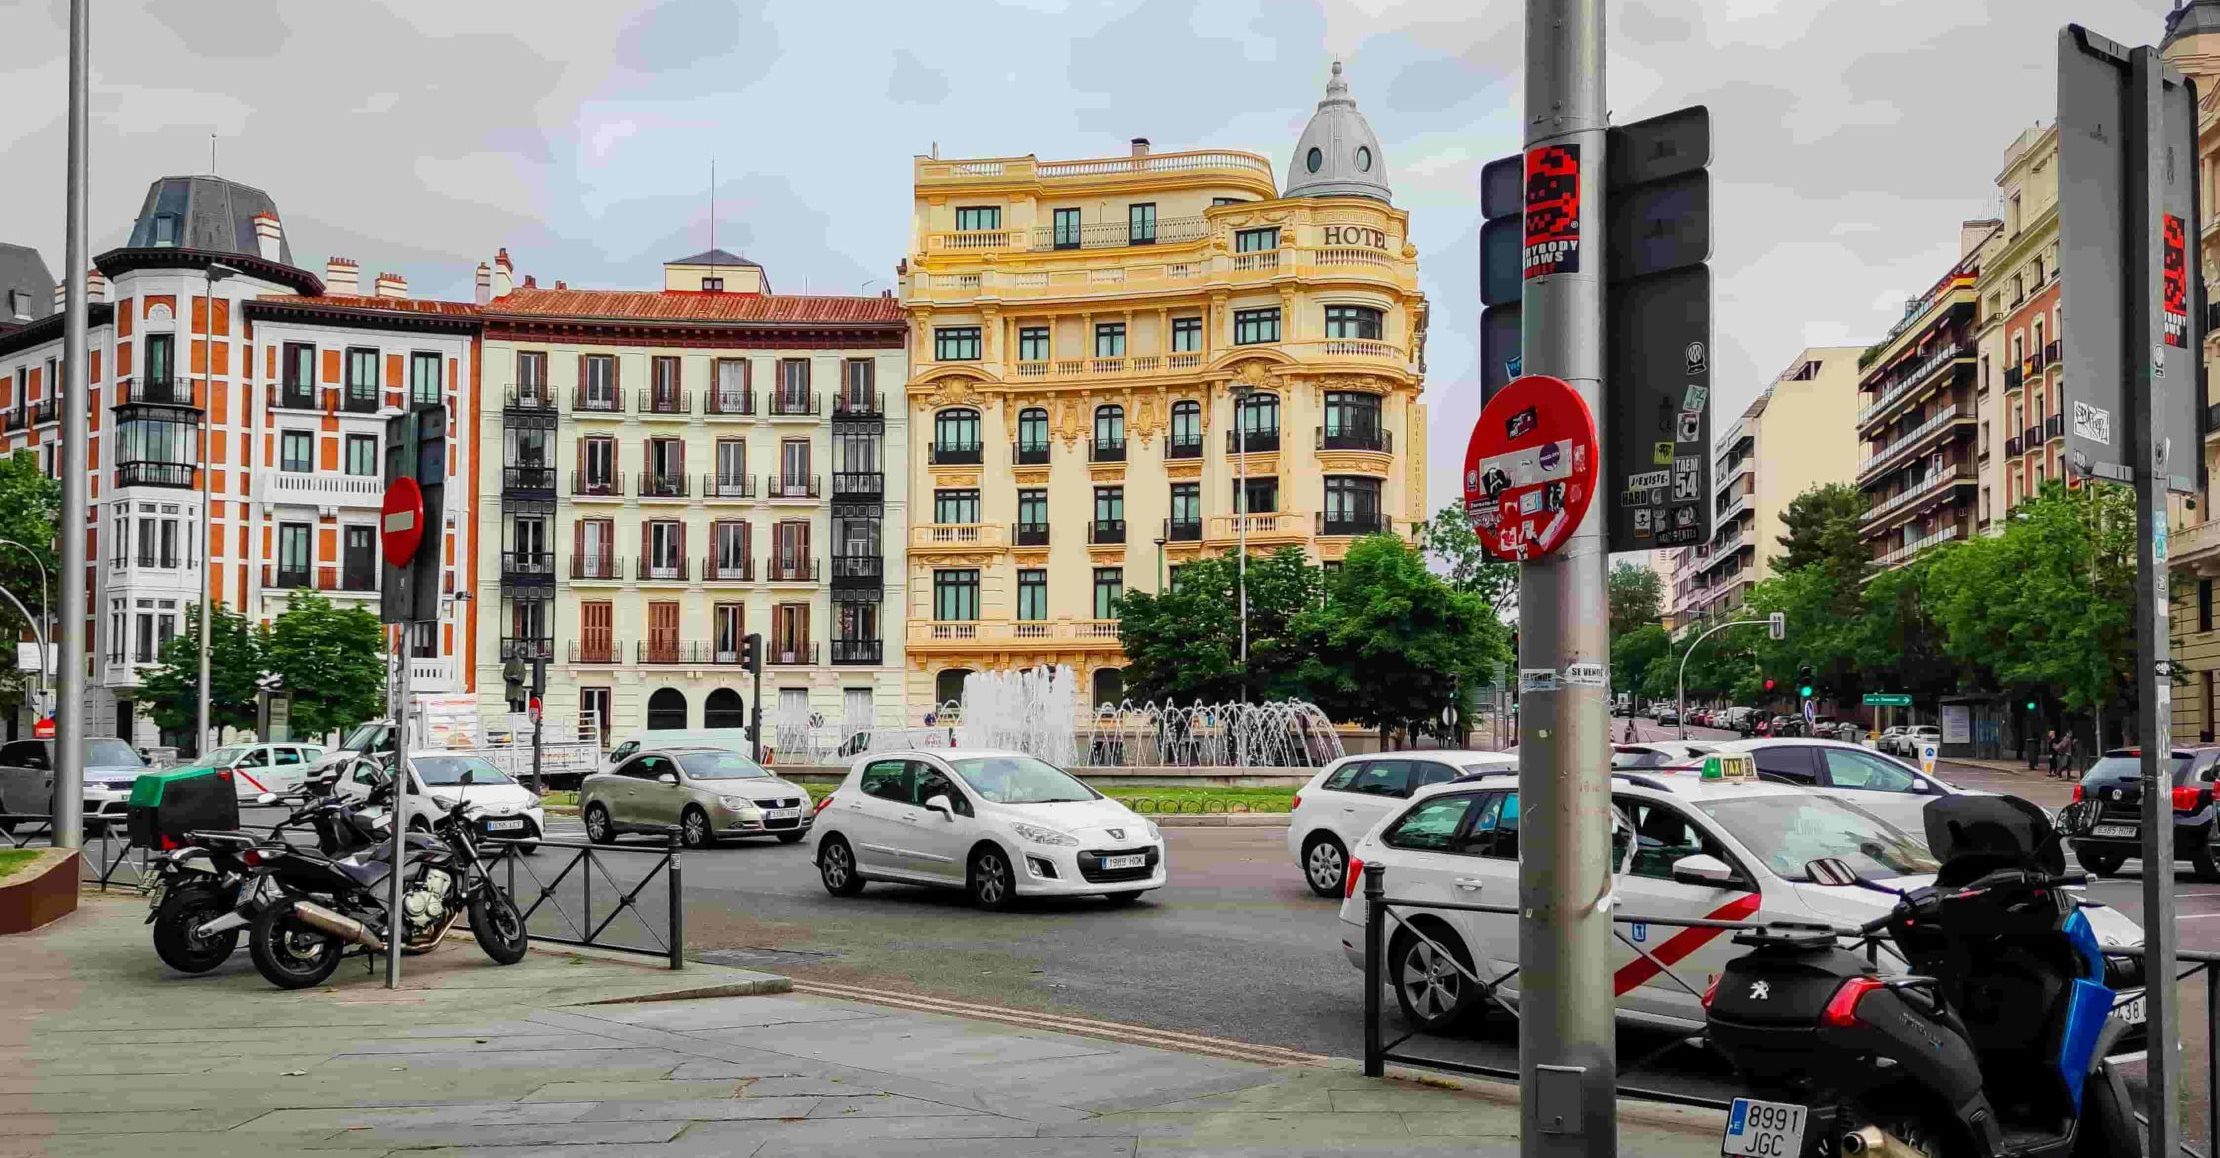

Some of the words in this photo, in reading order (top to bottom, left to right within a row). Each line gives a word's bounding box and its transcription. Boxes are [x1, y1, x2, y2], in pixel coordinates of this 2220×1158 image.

[1323, 226, 1388, 251] HOTEL
[1675, 472, 1698, 498] 54
[1623, 491, 1647, 506] HARD
[1571, 668, 1581, 676] SE
[1723, 759, 1744, 776] TAXI
[1748, 1105, 1798, 1133] 8991
[1745, 1132, 1784, 1157] JGC
